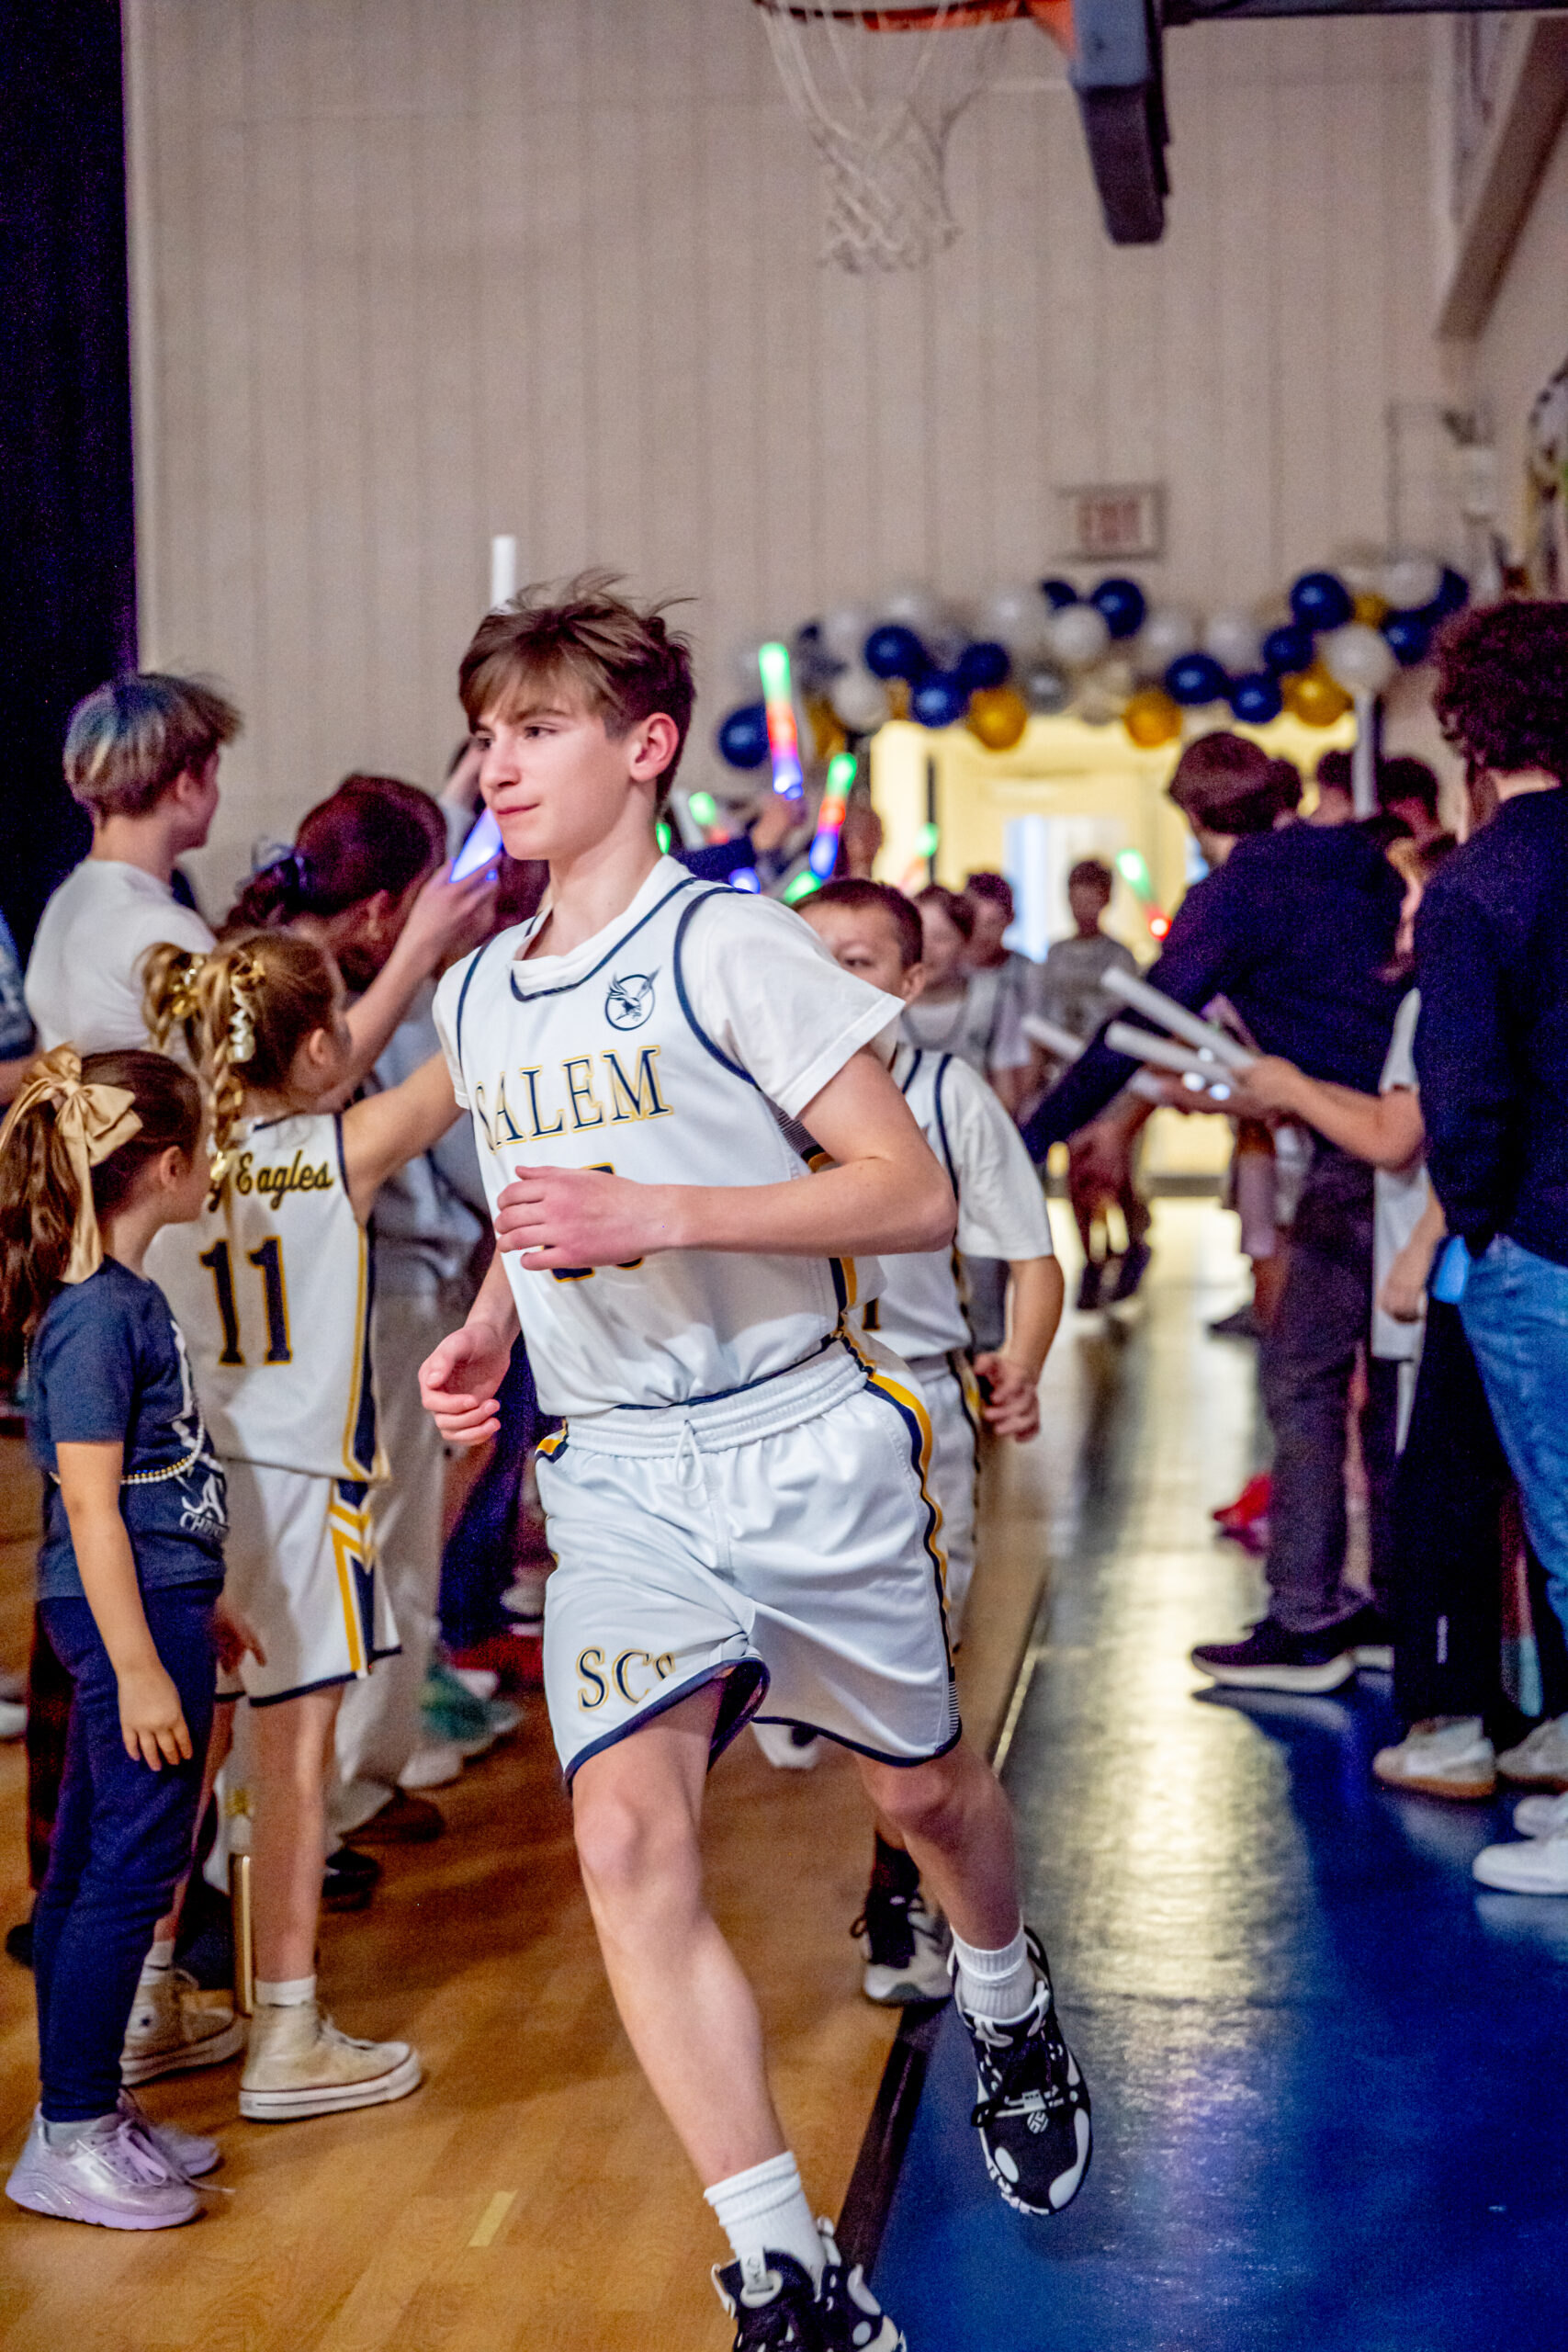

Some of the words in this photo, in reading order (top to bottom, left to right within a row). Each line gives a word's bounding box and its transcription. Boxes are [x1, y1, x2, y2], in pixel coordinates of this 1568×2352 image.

[476, 1045, 674, 1155] SALEM
[236, 1148, 333, 1211] Eagles
[199, 1235, 292, 1366] 11
